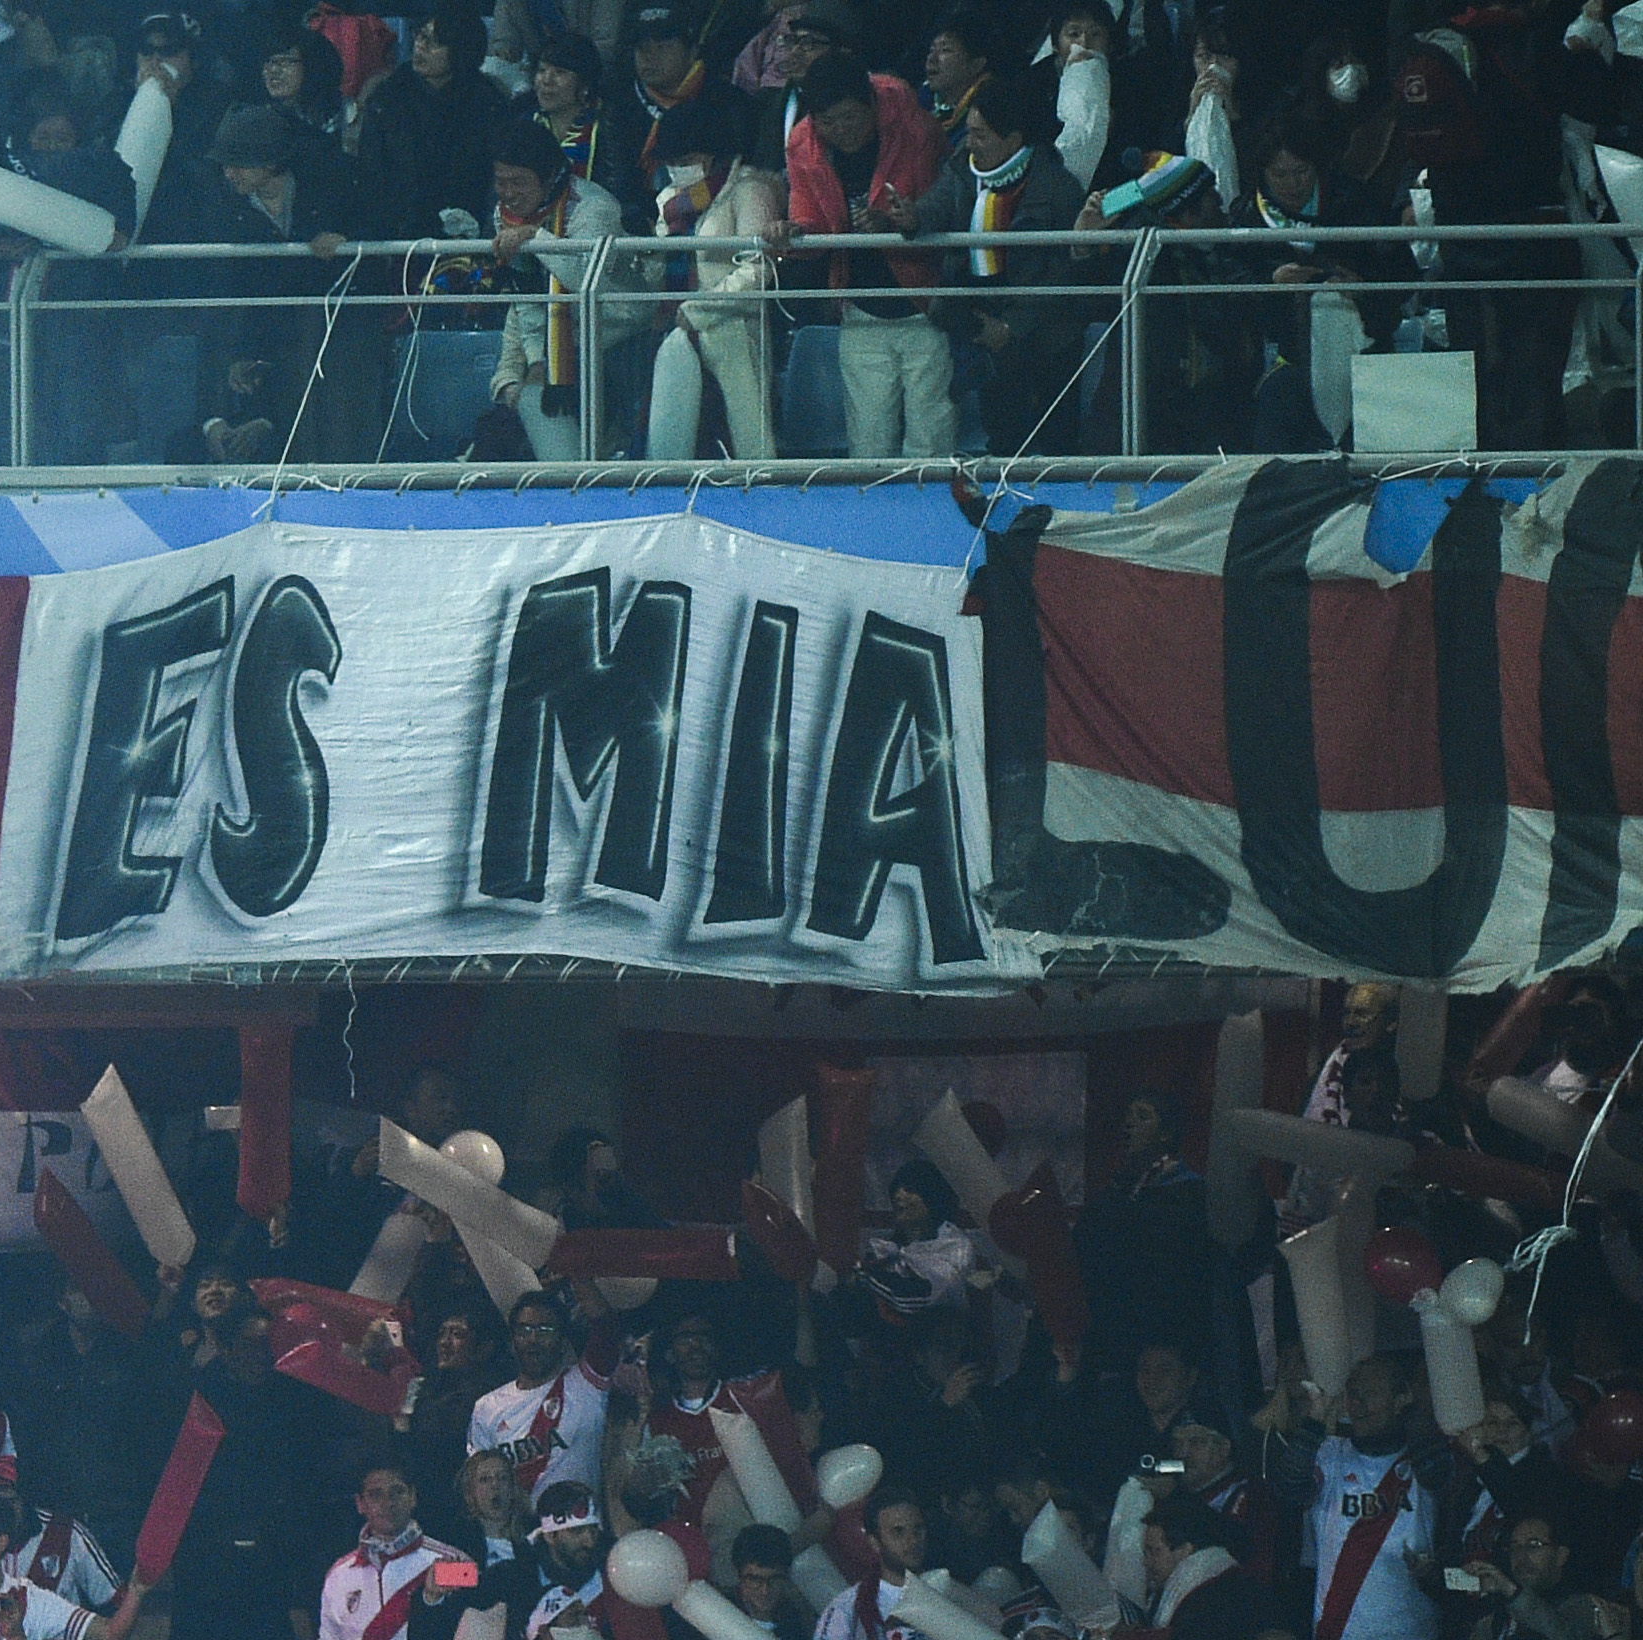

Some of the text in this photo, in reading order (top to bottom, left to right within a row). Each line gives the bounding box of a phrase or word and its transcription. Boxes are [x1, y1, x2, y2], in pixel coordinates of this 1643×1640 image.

[55, 573, 342, 942] ES
[477, 566, 986, 965] MIA
[498, 1430, 568, 1466] BBVA
[1341, 1488, 1414, 1519] BBVA
